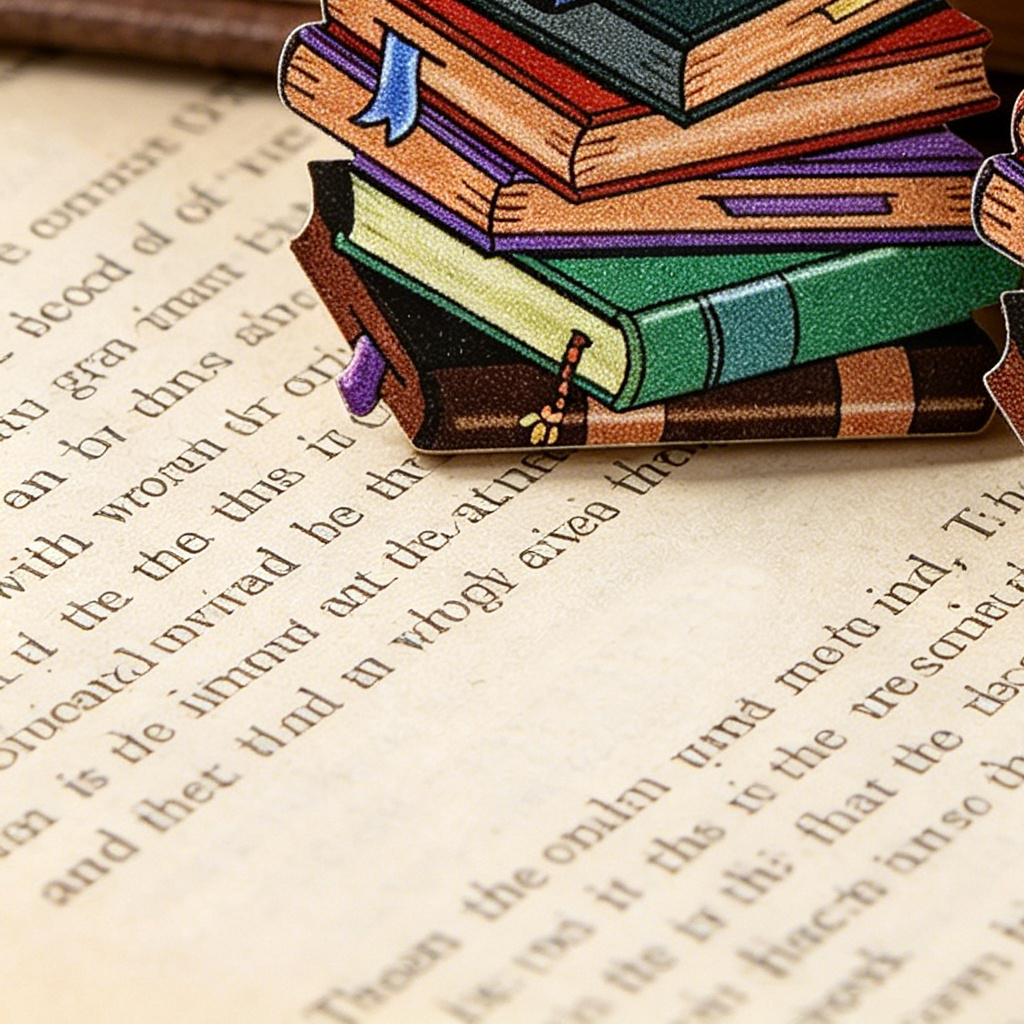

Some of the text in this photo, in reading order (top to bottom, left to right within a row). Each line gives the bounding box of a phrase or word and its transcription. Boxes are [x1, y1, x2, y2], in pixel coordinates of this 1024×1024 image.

[131, 532, 215, 582] the
[769, 729, 848, 780] the
[42, 828, 140, 907] and
[463, 868, 549, 923] the
